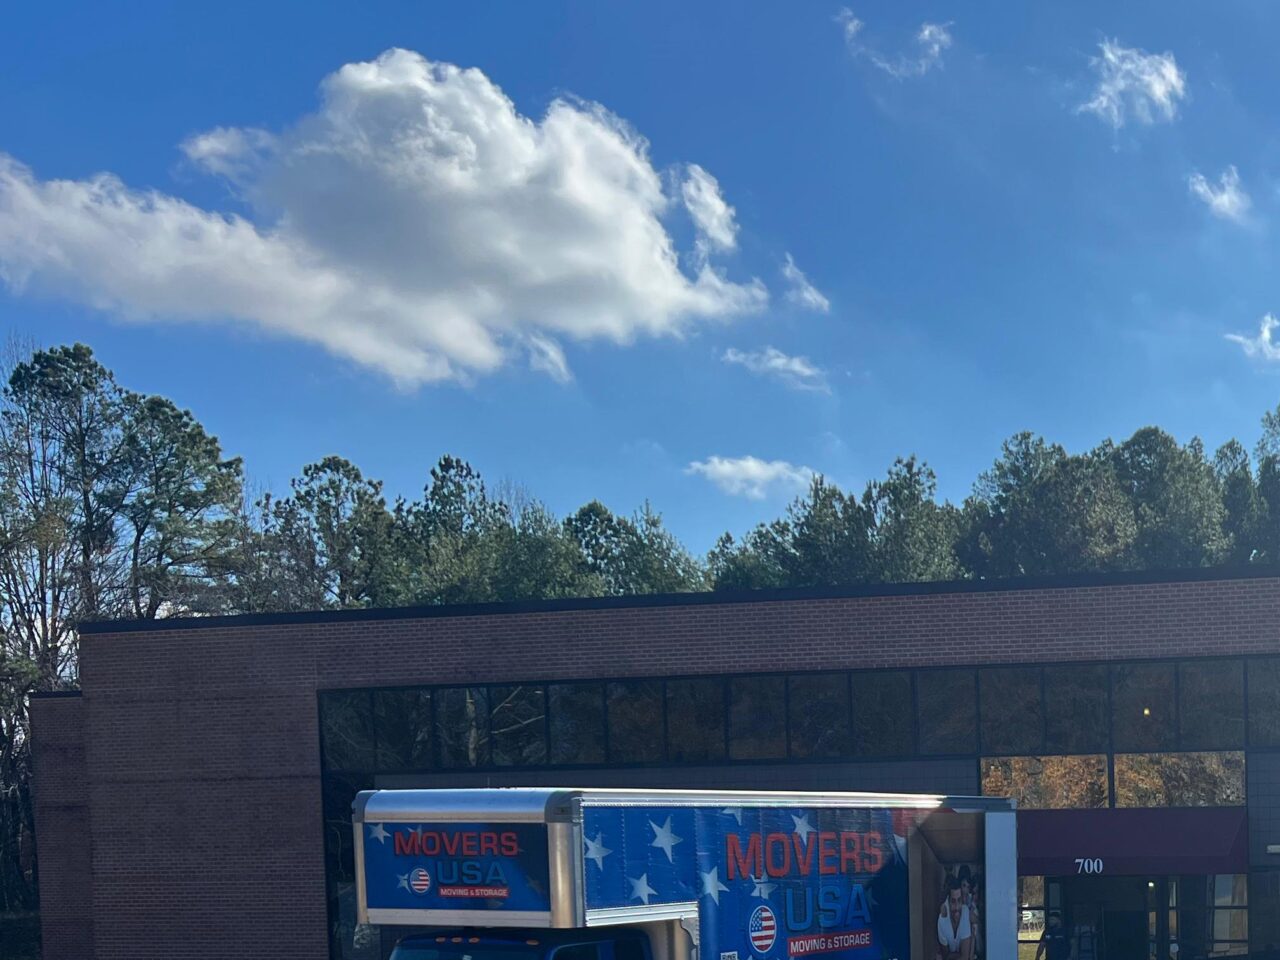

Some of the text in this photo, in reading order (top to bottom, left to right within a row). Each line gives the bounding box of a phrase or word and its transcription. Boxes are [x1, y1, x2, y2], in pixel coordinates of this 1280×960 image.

[394, 831, 519, 857] MOVERS
[727, 831, 883, 880] MOVERS
[436, 861, 508, 885] USA
[1074, 858, 1103, 874] 700
[440, 888, 470, 897] MOVING
[475, 888, 508, 897] STORAGE
[786, 884, 872, 931] USA
[790, 932, 871, 953] MOVING & STORAGE
